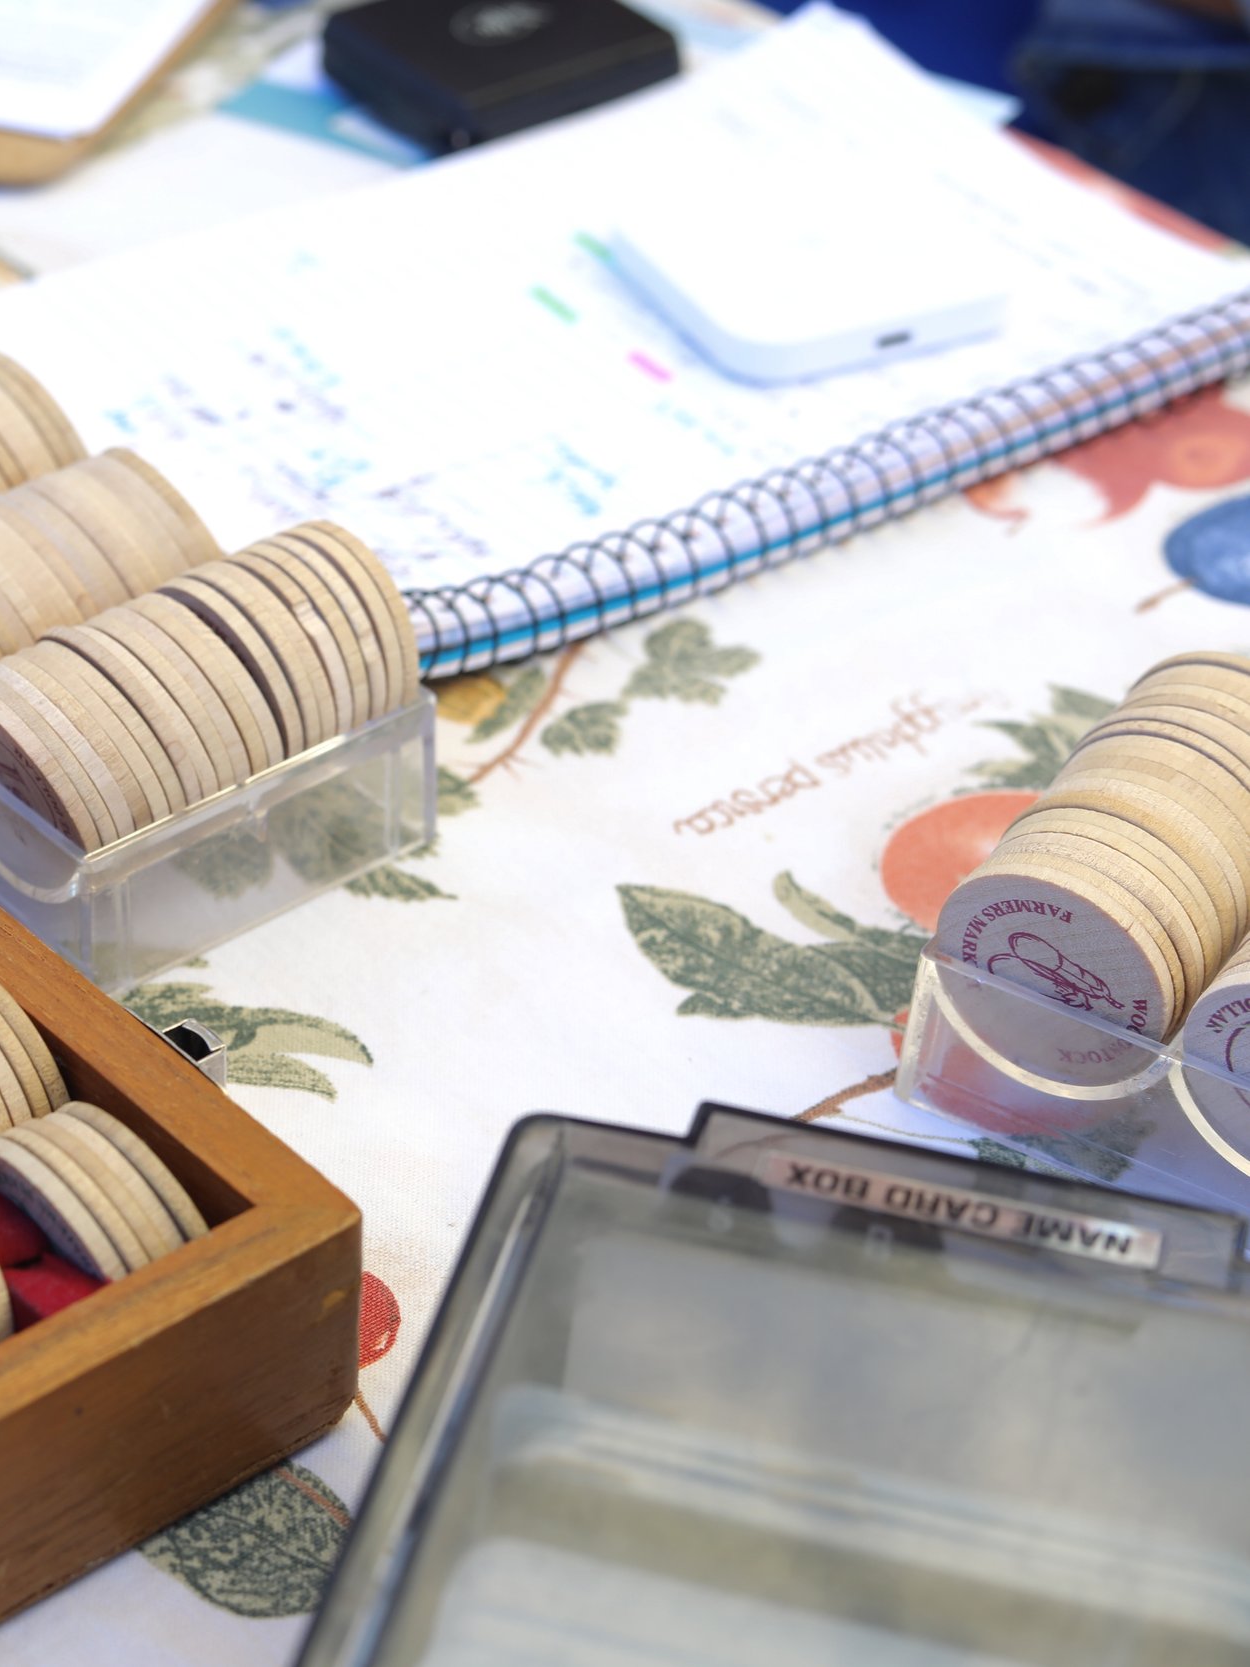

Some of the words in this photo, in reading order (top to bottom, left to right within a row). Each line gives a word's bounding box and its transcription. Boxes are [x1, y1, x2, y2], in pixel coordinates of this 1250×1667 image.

[980, 898, 1075, 925] FARMERS
[782, 1161, 873, 1203] BOX
[883, 1183, 1000, 1229] CARD
[1011, 1213, 1133, 1257] NAME
